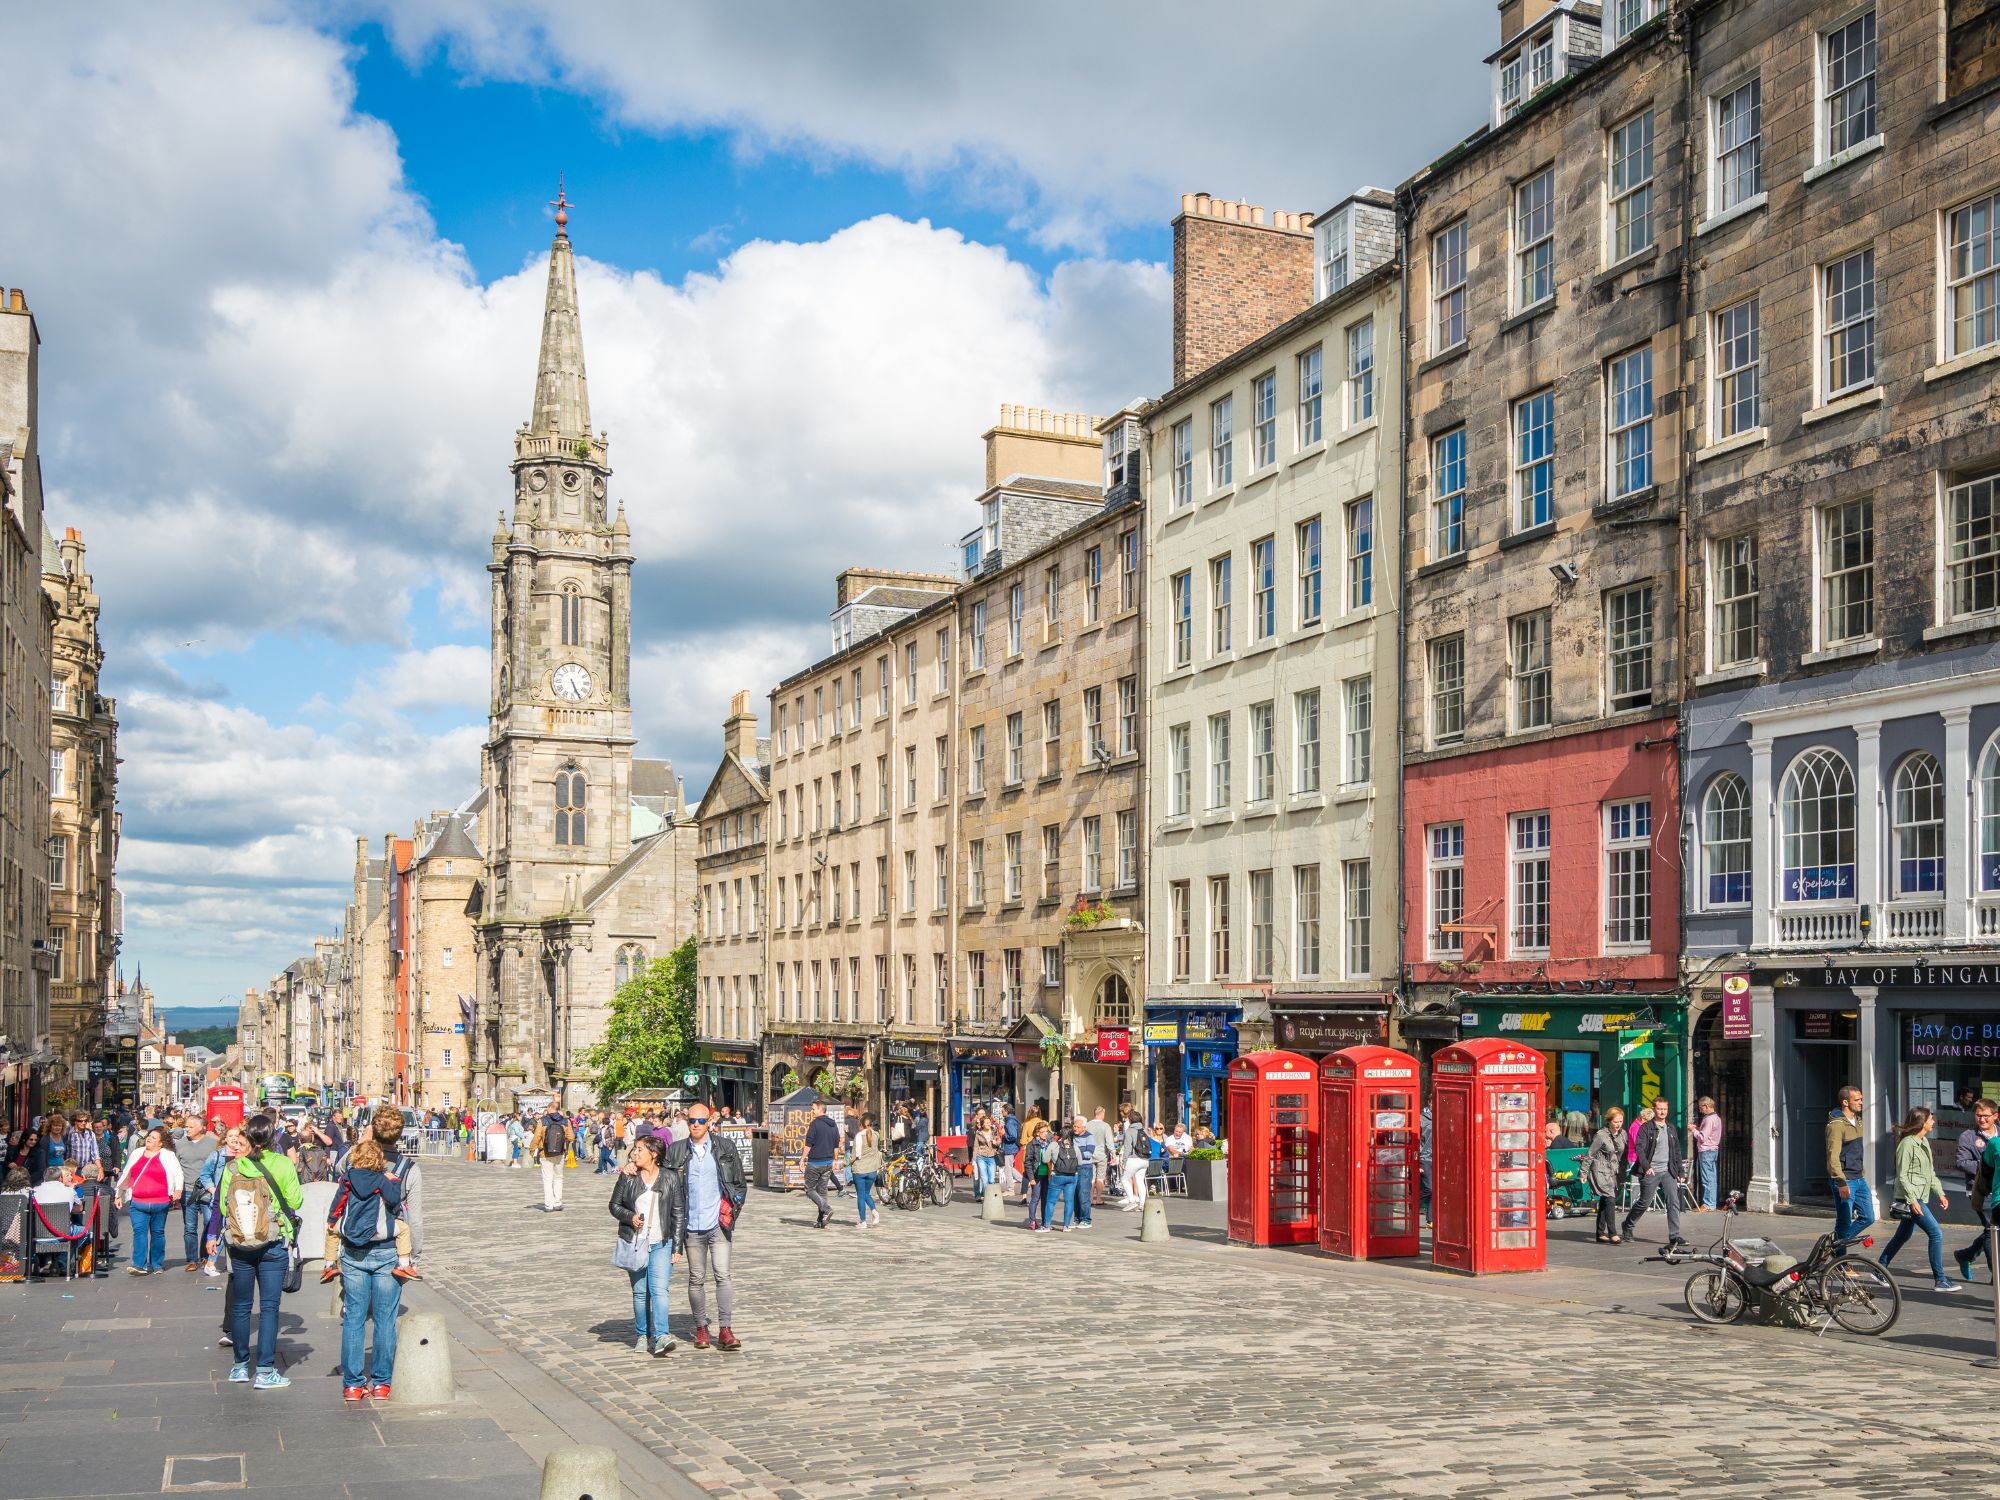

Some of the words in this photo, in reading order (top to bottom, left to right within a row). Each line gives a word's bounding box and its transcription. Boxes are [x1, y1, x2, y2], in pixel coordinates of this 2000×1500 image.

[1825, 969, 1859, 984] BAY
[1873, 968, 1897, 984] OF
[1914, 967, 2000, 984] BENGAL
[1498, 1011, 1551, 1031] SUBWAY
[1913, 1023, 1944, 1039] BAY
[1951, 1025, 1975, 1040] OF
[1619, 1029, 1651, 1058] SUBWAY
[1912, 1044, 1961, 1057] INDIAN
[1964, 1045, 2000, 1058] REST
[1487, 1064, 1534, 1073] TELEPHONE
[768, 1110, 784, 1123] FREE
[829, 1110, 844, 1121] REE
[723, 1130, 745, 1139] PUB
